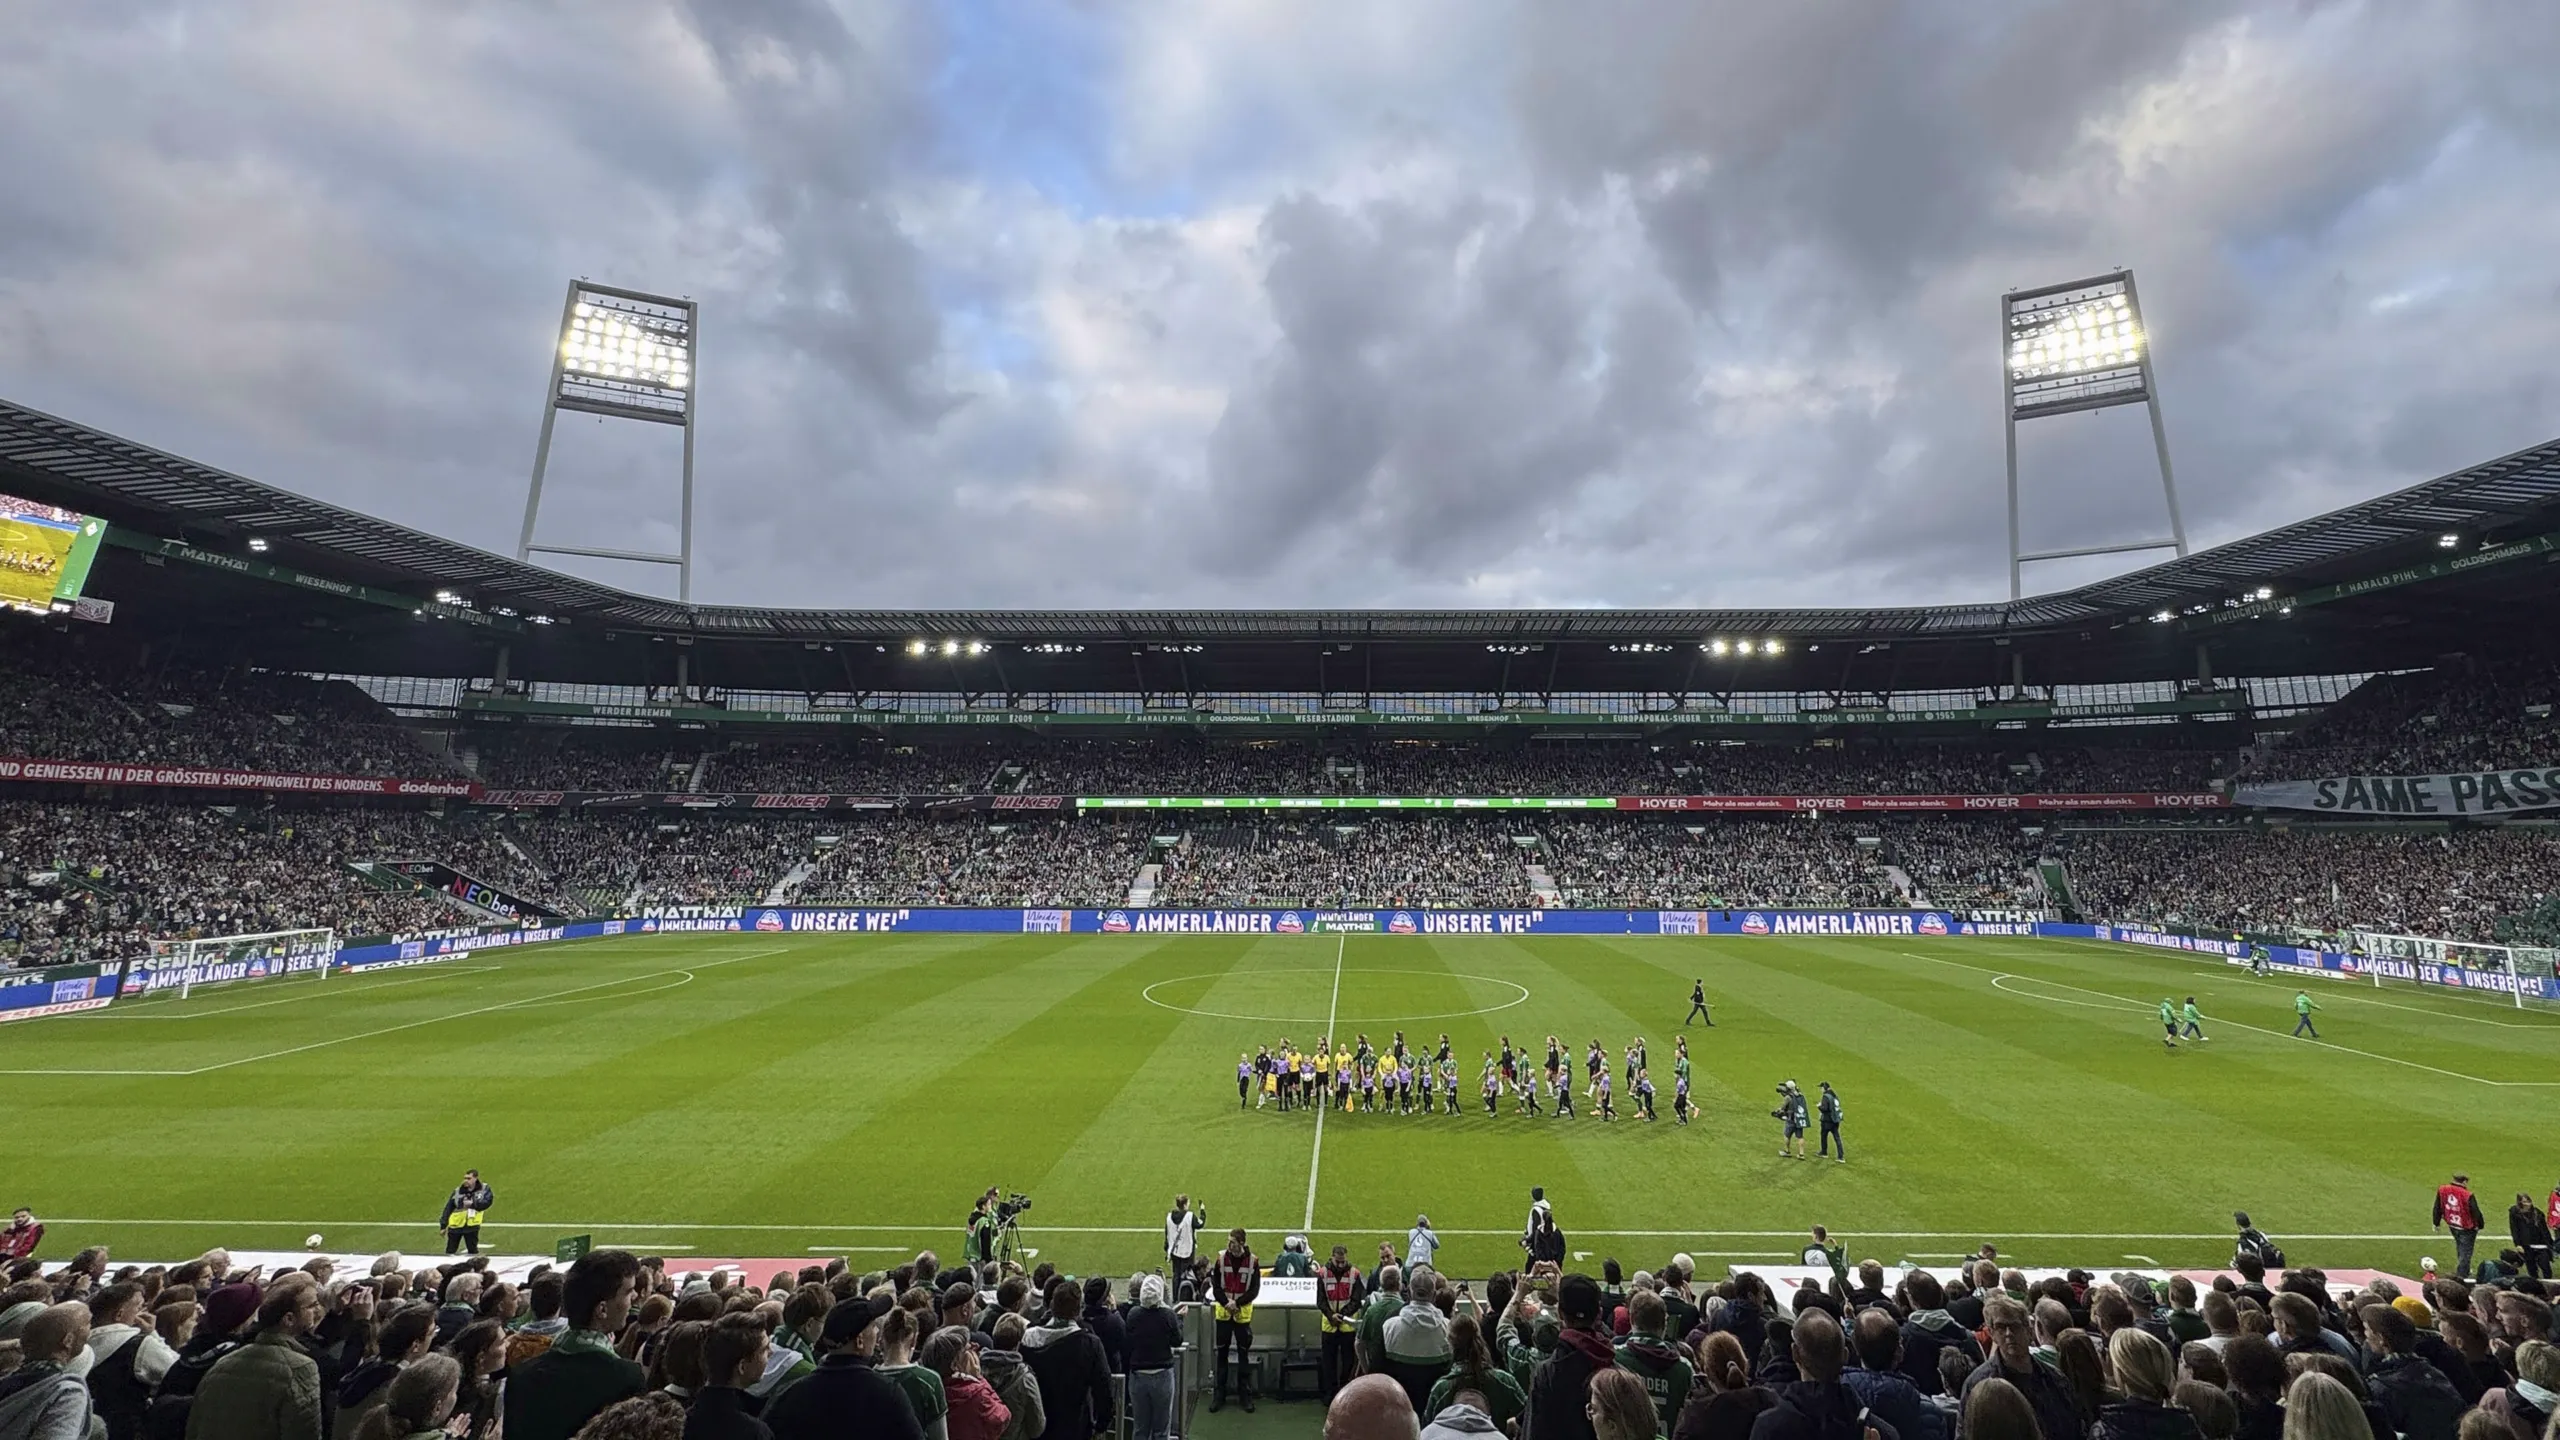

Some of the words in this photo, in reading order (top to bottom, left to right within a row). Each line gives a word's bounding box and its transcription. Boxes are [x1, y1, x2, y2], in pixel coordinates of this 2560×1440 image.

[2451, 543, 2531, 569] GOLDSCHMAUS
[295, 573, 352, 594] WIESENHOF
[2349, 576, 2390, 593] HARALD
[2392, 570, 2419, 583] PIHL
[423, 602, 458, 618] WERDER
[460, 610, 494, 625] BREMEN
[593, 706, 631, 716] WERDER
[634, 708, 672, 717] BREMEN
[2051, 706, 2091, 716] WERDER
[2094, 704, 2134, 714] BREMEN
[784, 713, 841, 722] POKALSIEGER
[981, 714, 999, 723] 2004
[1013, 714, 1033, 723] 2009
[1137, 715, 1167, 723] HARALD
[1295, 714, 1356, 723] WESERSTADION
[1613, 714, 1701, 723] EUROPAPOKAL-SIEGER
[1762, 714, 1797, 722] MEISTER
[1818, 714, 1838, 722] 2004
[23, 764, 105, 781] GENIESSEN
[107, 768, 123, 781] IN
[126, 769, 153, 782] DER
[156, 768, 221, 785] GRÖSSTEN
[223, 774, 311, 789] SHOPPINGWELT
[312, 777, 332, 790] DES
[334, 778, 384, 792] NORDENS.
[399, 781, 471, 795] dodenhof
[2313, 776, 2438, 813] SAME
[752, 794, 830, 808] HILKER
[991, 796, 1063, 809] HILKER
[1640, 798, 1688, 808] HOYER
[1796, 798, 1846, 808] HOYER
[1963, 797, 2020, 807] HOYER
[2154, 795, 2219, 806] HOYER
[790, 912, 859, 931] UNSERE
[1135, 910, 1272, 933] AMMERLÄNDER
[1315, 912, 1374, 922] AMMLÄNDER
[1423, 913, 1493, 933] UNSERE
[1774, 912, 1913, 934] AMMERLÄNDER
[1955, 910, 2044, 922] ATTHÄI
[659, 918, 725, 931] AMMERLÄNDER
[1977, 923, 2013, 935] UNSERE
[452, 933, 511, 952] AMMERLÄNDER
[524, 929, 549, 943] UNSERE
[2131, 931, 2182, 949] AMMERLÄNDER
[2194, 938, 2224, 954] UNSERE
[147, 961, 247, 990] AMMERLÄNDER
[2464, 970, 2515, 993] UNSERE
[1642, 1377, 1669, 1393] DER
